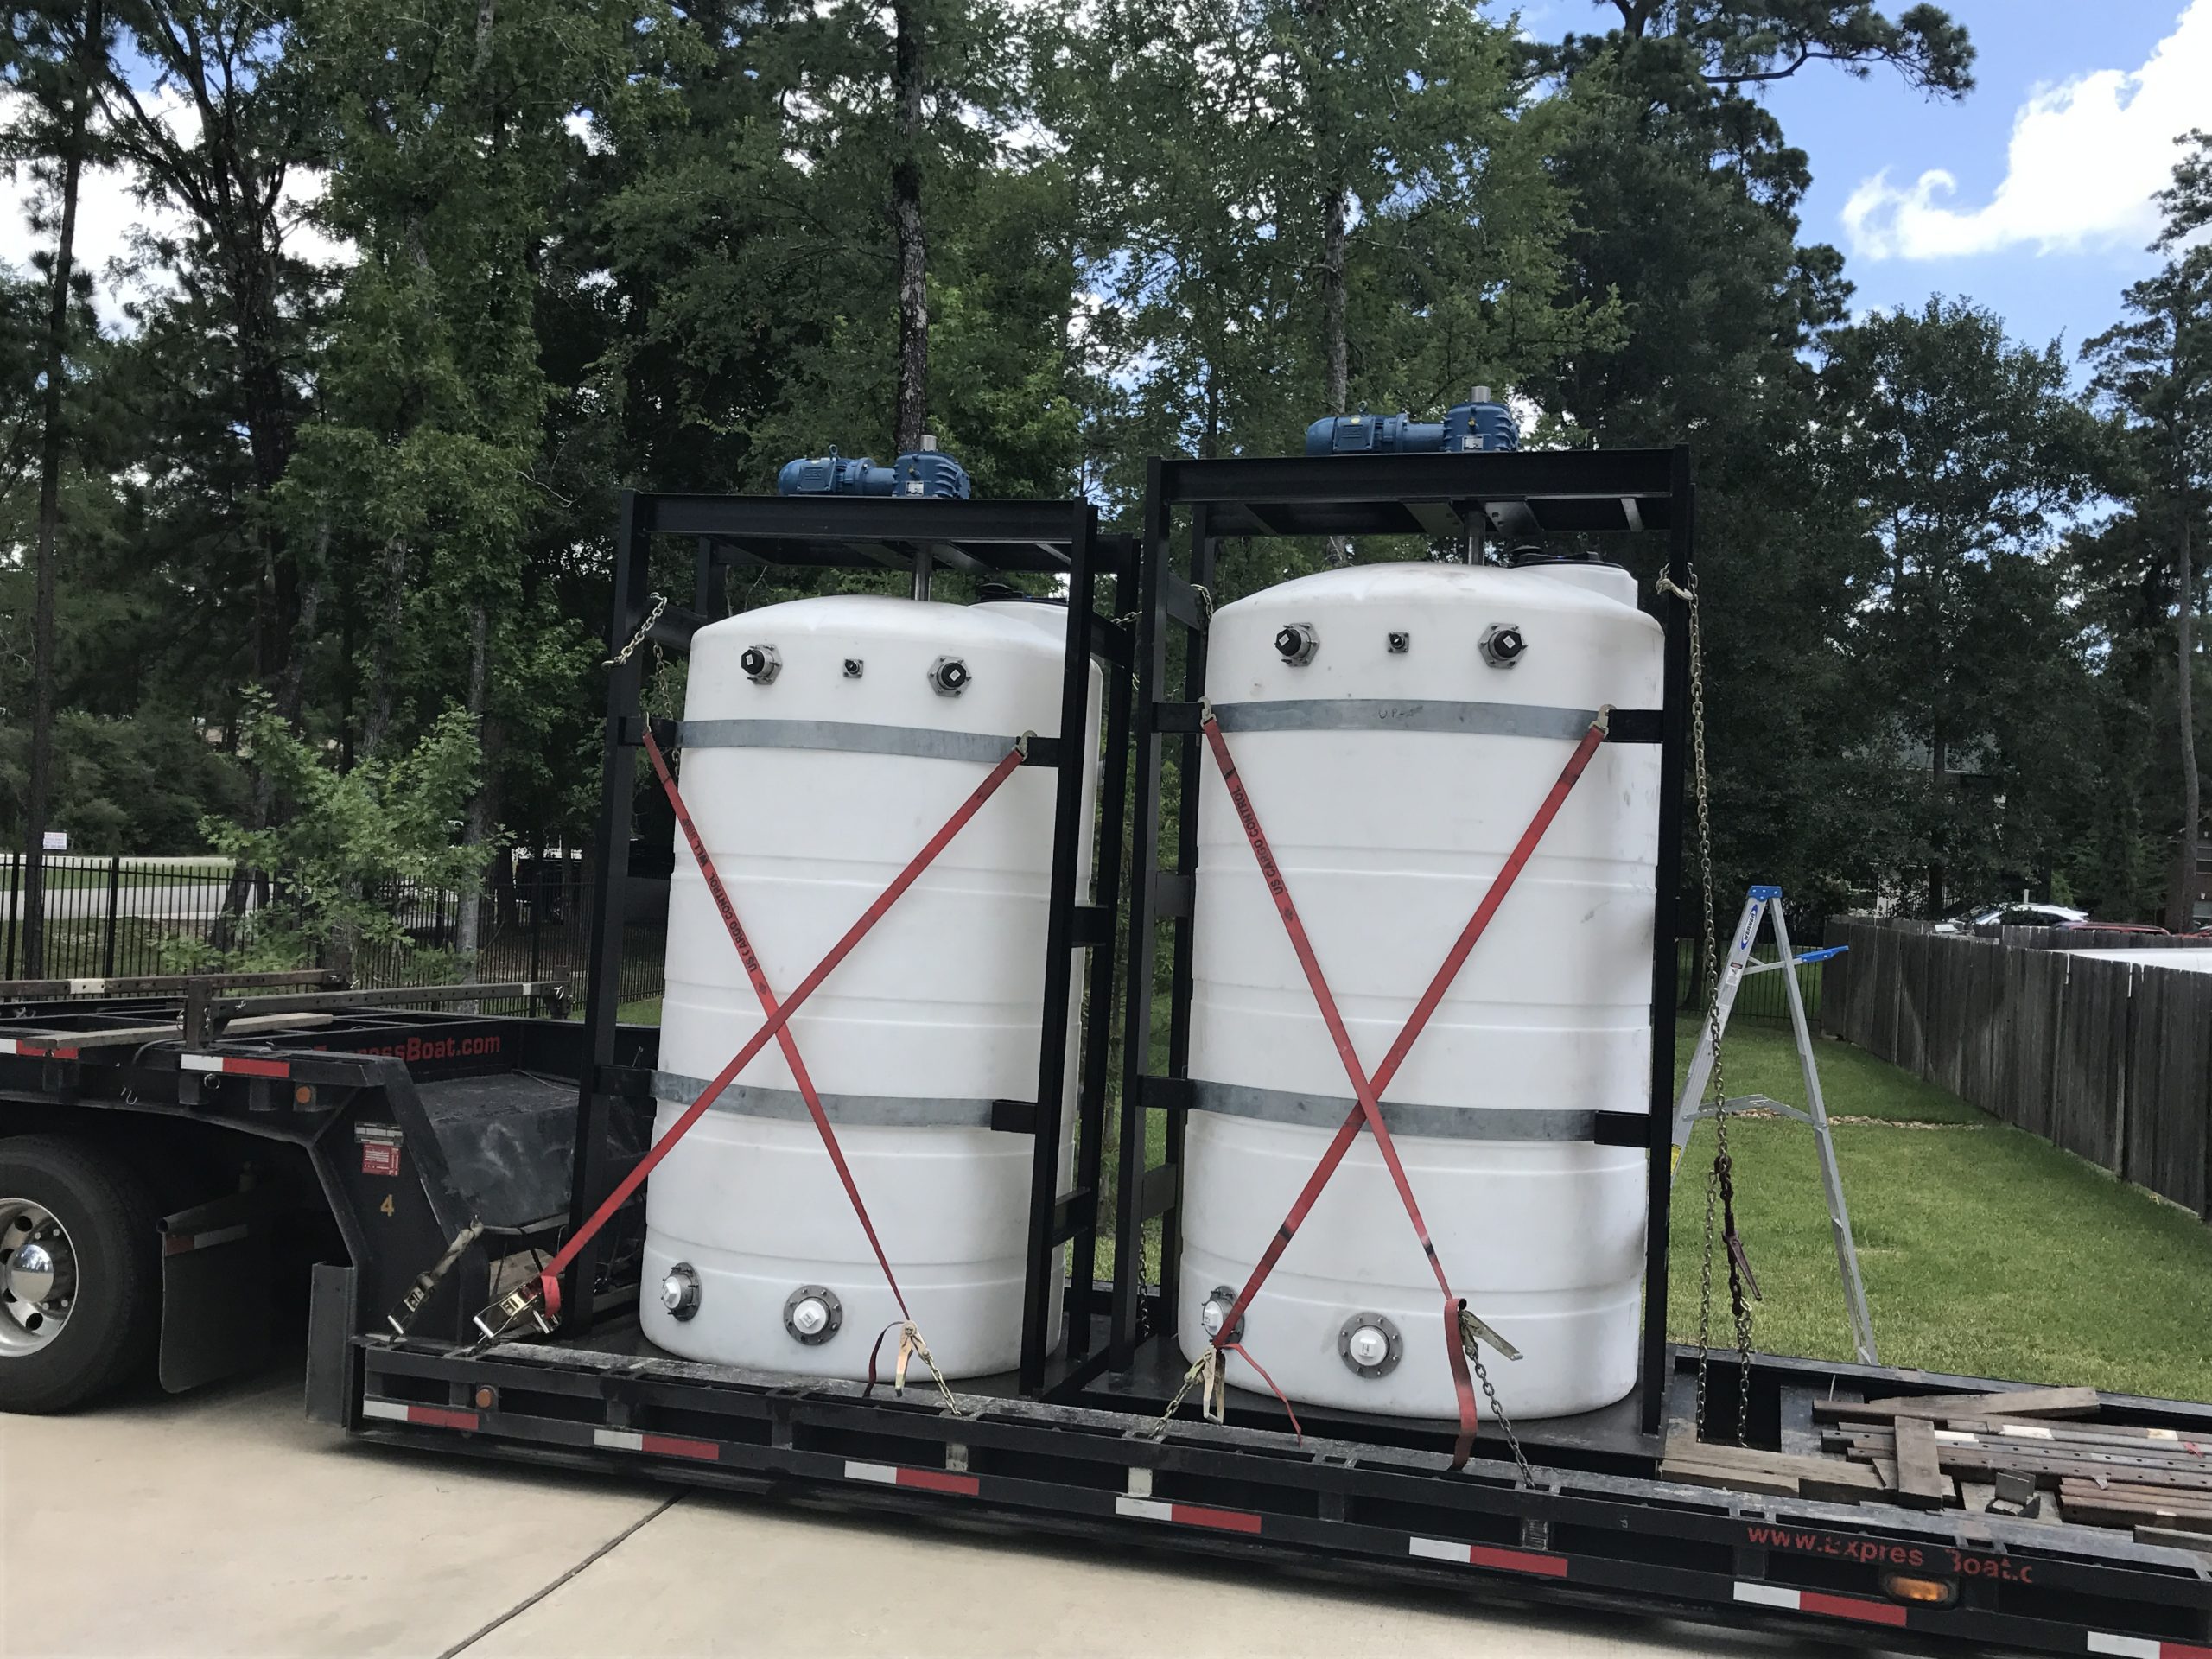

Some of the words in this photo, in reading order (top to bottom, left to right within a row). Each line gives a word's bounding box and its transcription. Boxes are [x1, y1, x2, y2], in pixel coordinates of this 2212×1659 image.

[1231, 785, 1259, 837] CONTROL
[1253, 839, 1275, 877] CARGO
[708, 873, 733, 919] CONTROL
[1271, 879, 1283, 894] US
[729, 920, 750, 956] CARGO
[1744, 912, 1755, 940] WERNER
[746, 957, 758, 972] US
[380, 1194, 395, 1217] 4
